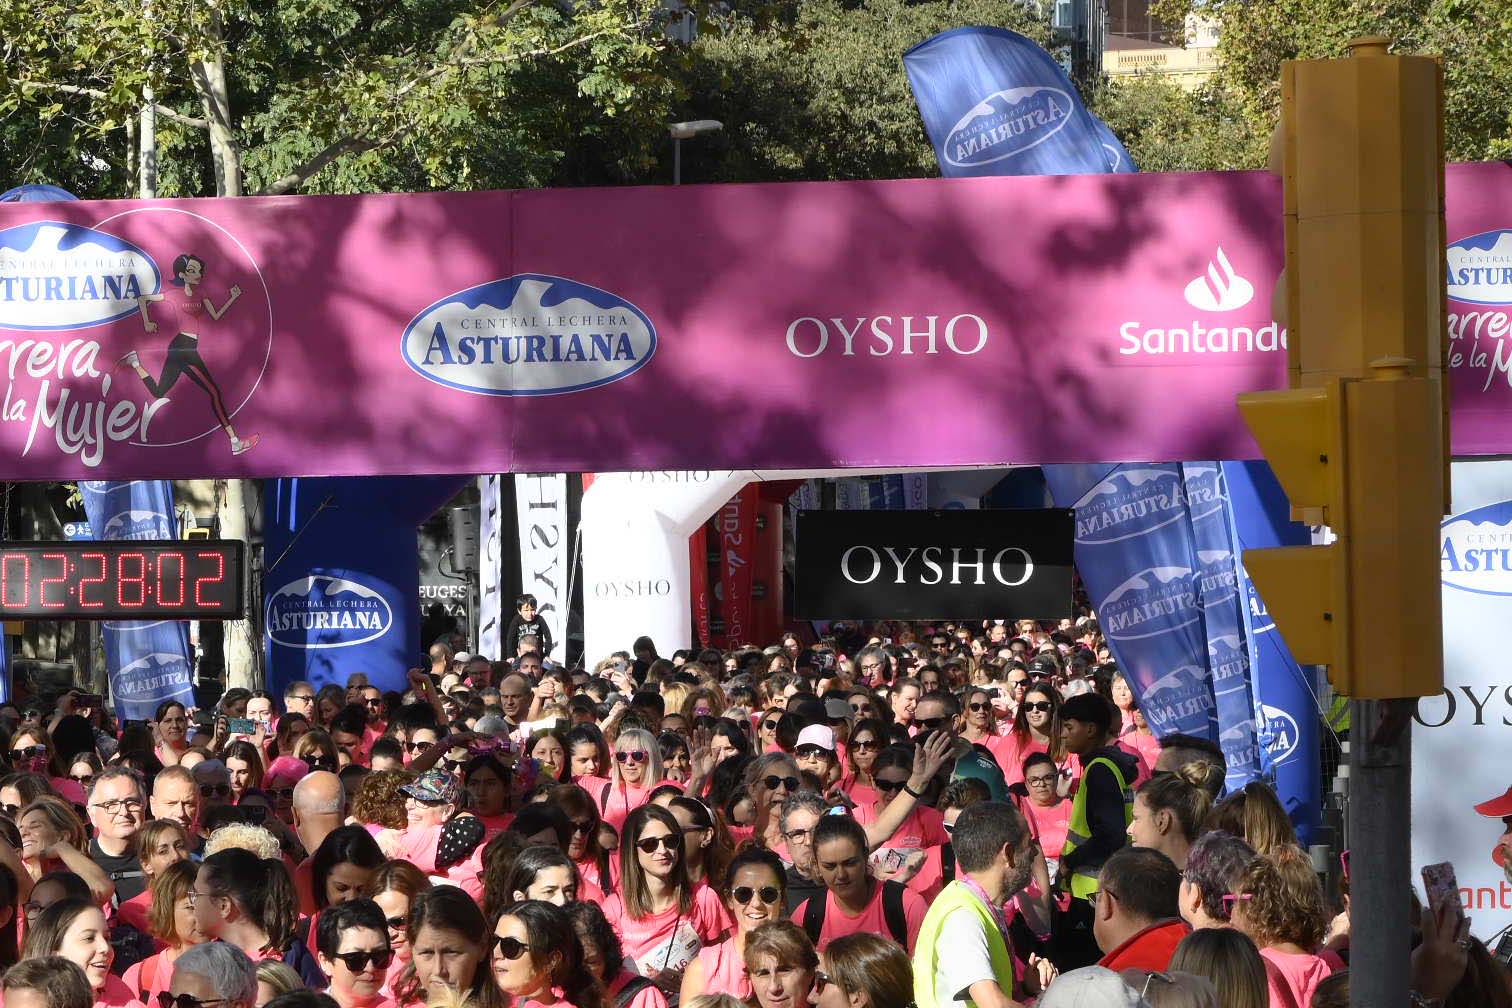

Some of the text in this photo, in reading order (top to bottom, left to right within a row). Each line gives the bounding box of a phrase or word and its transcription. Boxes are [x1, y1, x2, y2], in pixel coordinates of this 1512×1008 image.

[460, 313, 629, 330] CENTRAL LECHERA
[786, 313, 988, 359] OYSHO
[421, 321, 636, 367] ASTURIANA
[1469, 341, 1487, 368] la
[2, 381, 27, 422] la
[22, 374, 170, 467] Mujer
[1, 552, 225, 609] 02:28:02
[840, 545, 1035, 588] OYSHO
[330, 599, 378, 608] LECHERA
[595, 579, 671, 598] OYSHO
[270, 607, 383, 632] ASTURIANA
